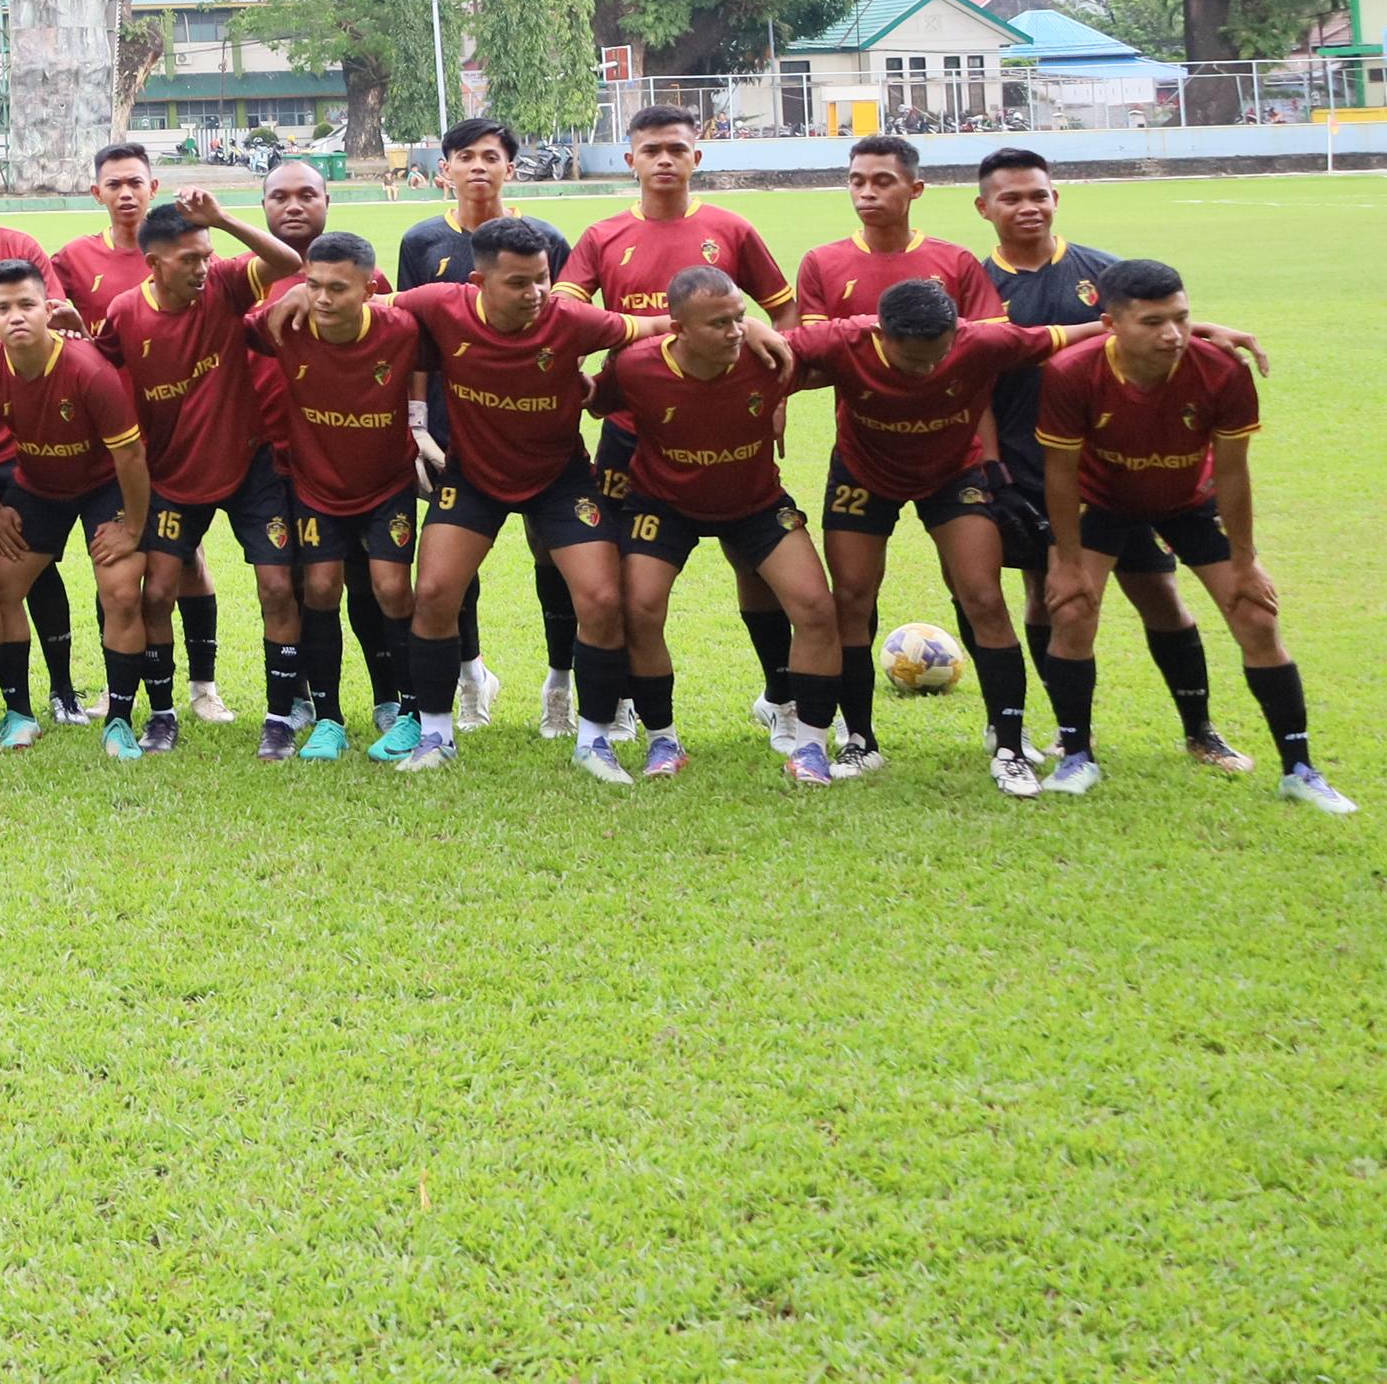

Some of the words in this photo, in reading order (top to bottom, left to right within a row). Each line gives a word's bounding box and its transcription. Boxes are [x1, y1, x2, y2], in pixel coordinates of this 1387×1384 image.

[301, 407, 396, 428] ENDAGIR
[438, 487, 457, 511] 9
[602, 469, 628, 500] 12
[831, 484, 869, 516] 22
[158, 510, 182, 541] 15
[297, 517, 321, 547] 14
[631, 513, 660, 542] 16
